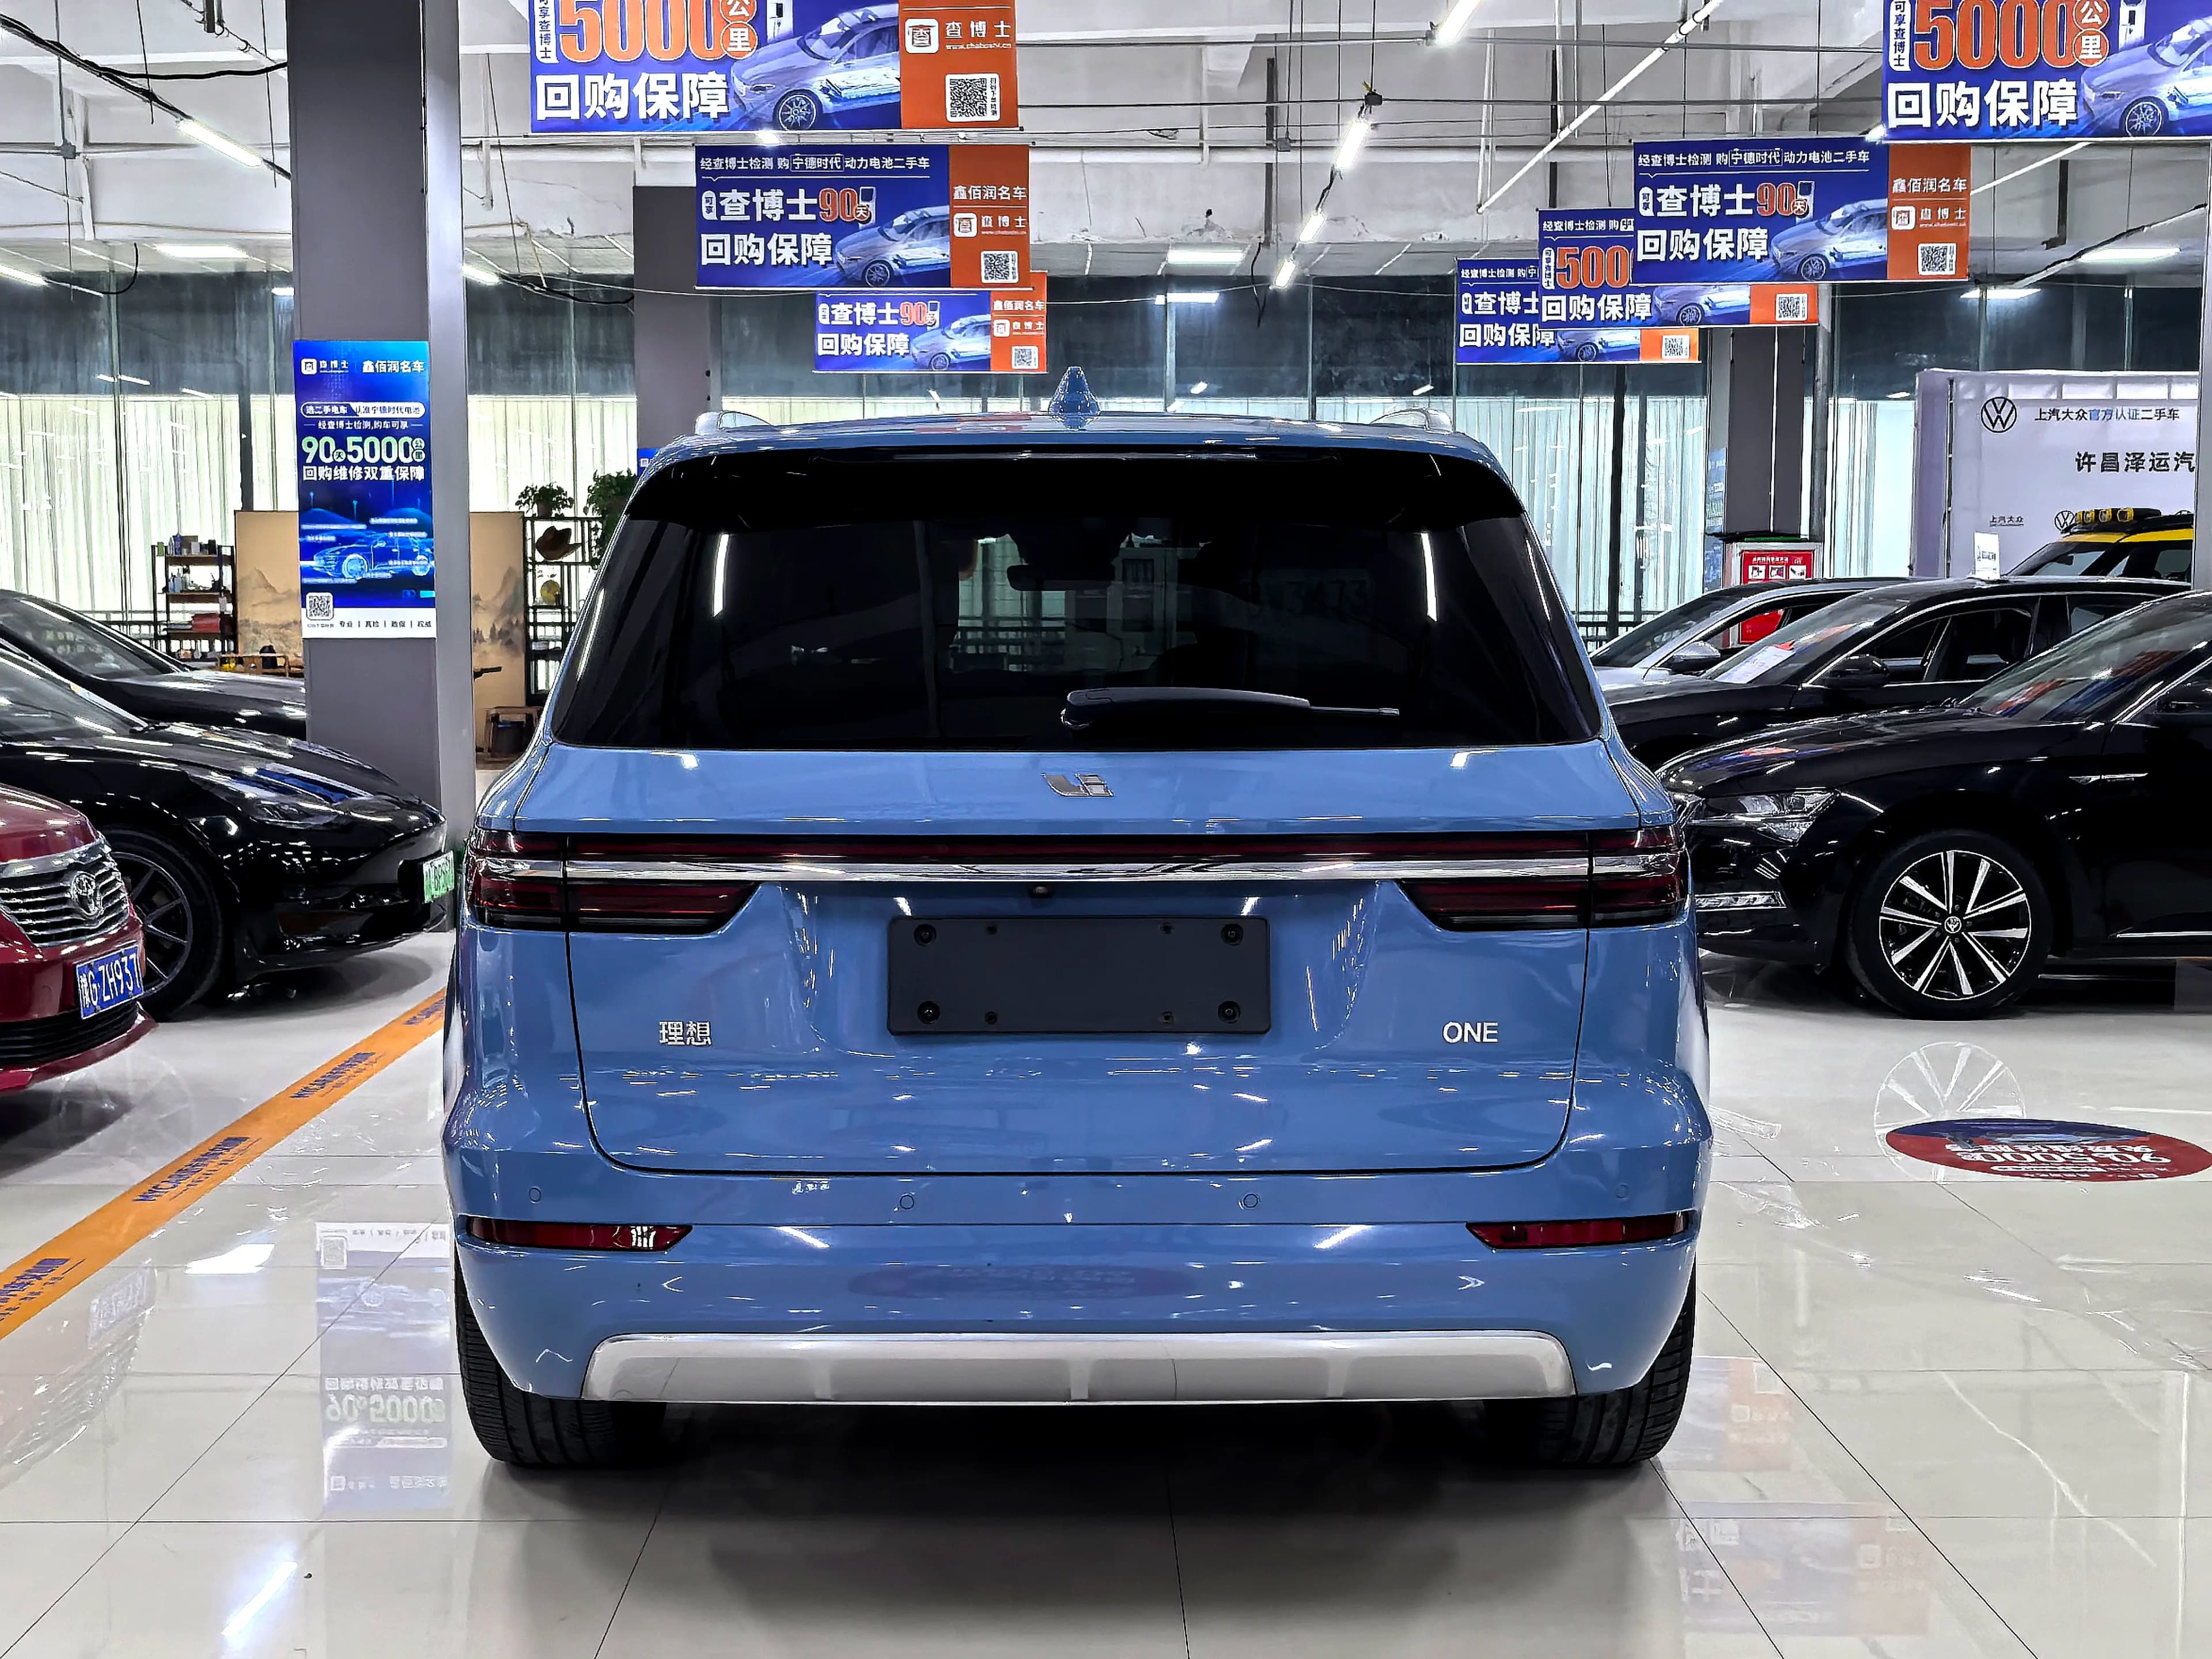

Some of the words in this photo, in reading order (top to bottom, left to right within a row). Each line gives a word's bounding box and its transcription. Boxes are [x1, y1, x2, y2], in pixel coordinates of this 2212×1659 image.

[536, 70, 730, 120] 回购保障
[1887, 78, 2078, 128] 回购保障
[700, 232, 833, 266] 回购保障
[1636, 225, 1769, 262] 回购保障
[1556, 245, 1634, 289] 500
[1474, 290, 1540, 316] 查博士
[1541, 293, 1652, 322] 回购保障
[817, 333, 911, 357] 回购保障
[1460, 323, 1555, 347] 回购保障
[303, 465, 425, 481] 回购维修双重保障
[2075, 451, 2196, 473] 许昌泽运汽
[658, 1021, 712, 1046] 理想
[1442, 1021, 1498, 1043] ONE
